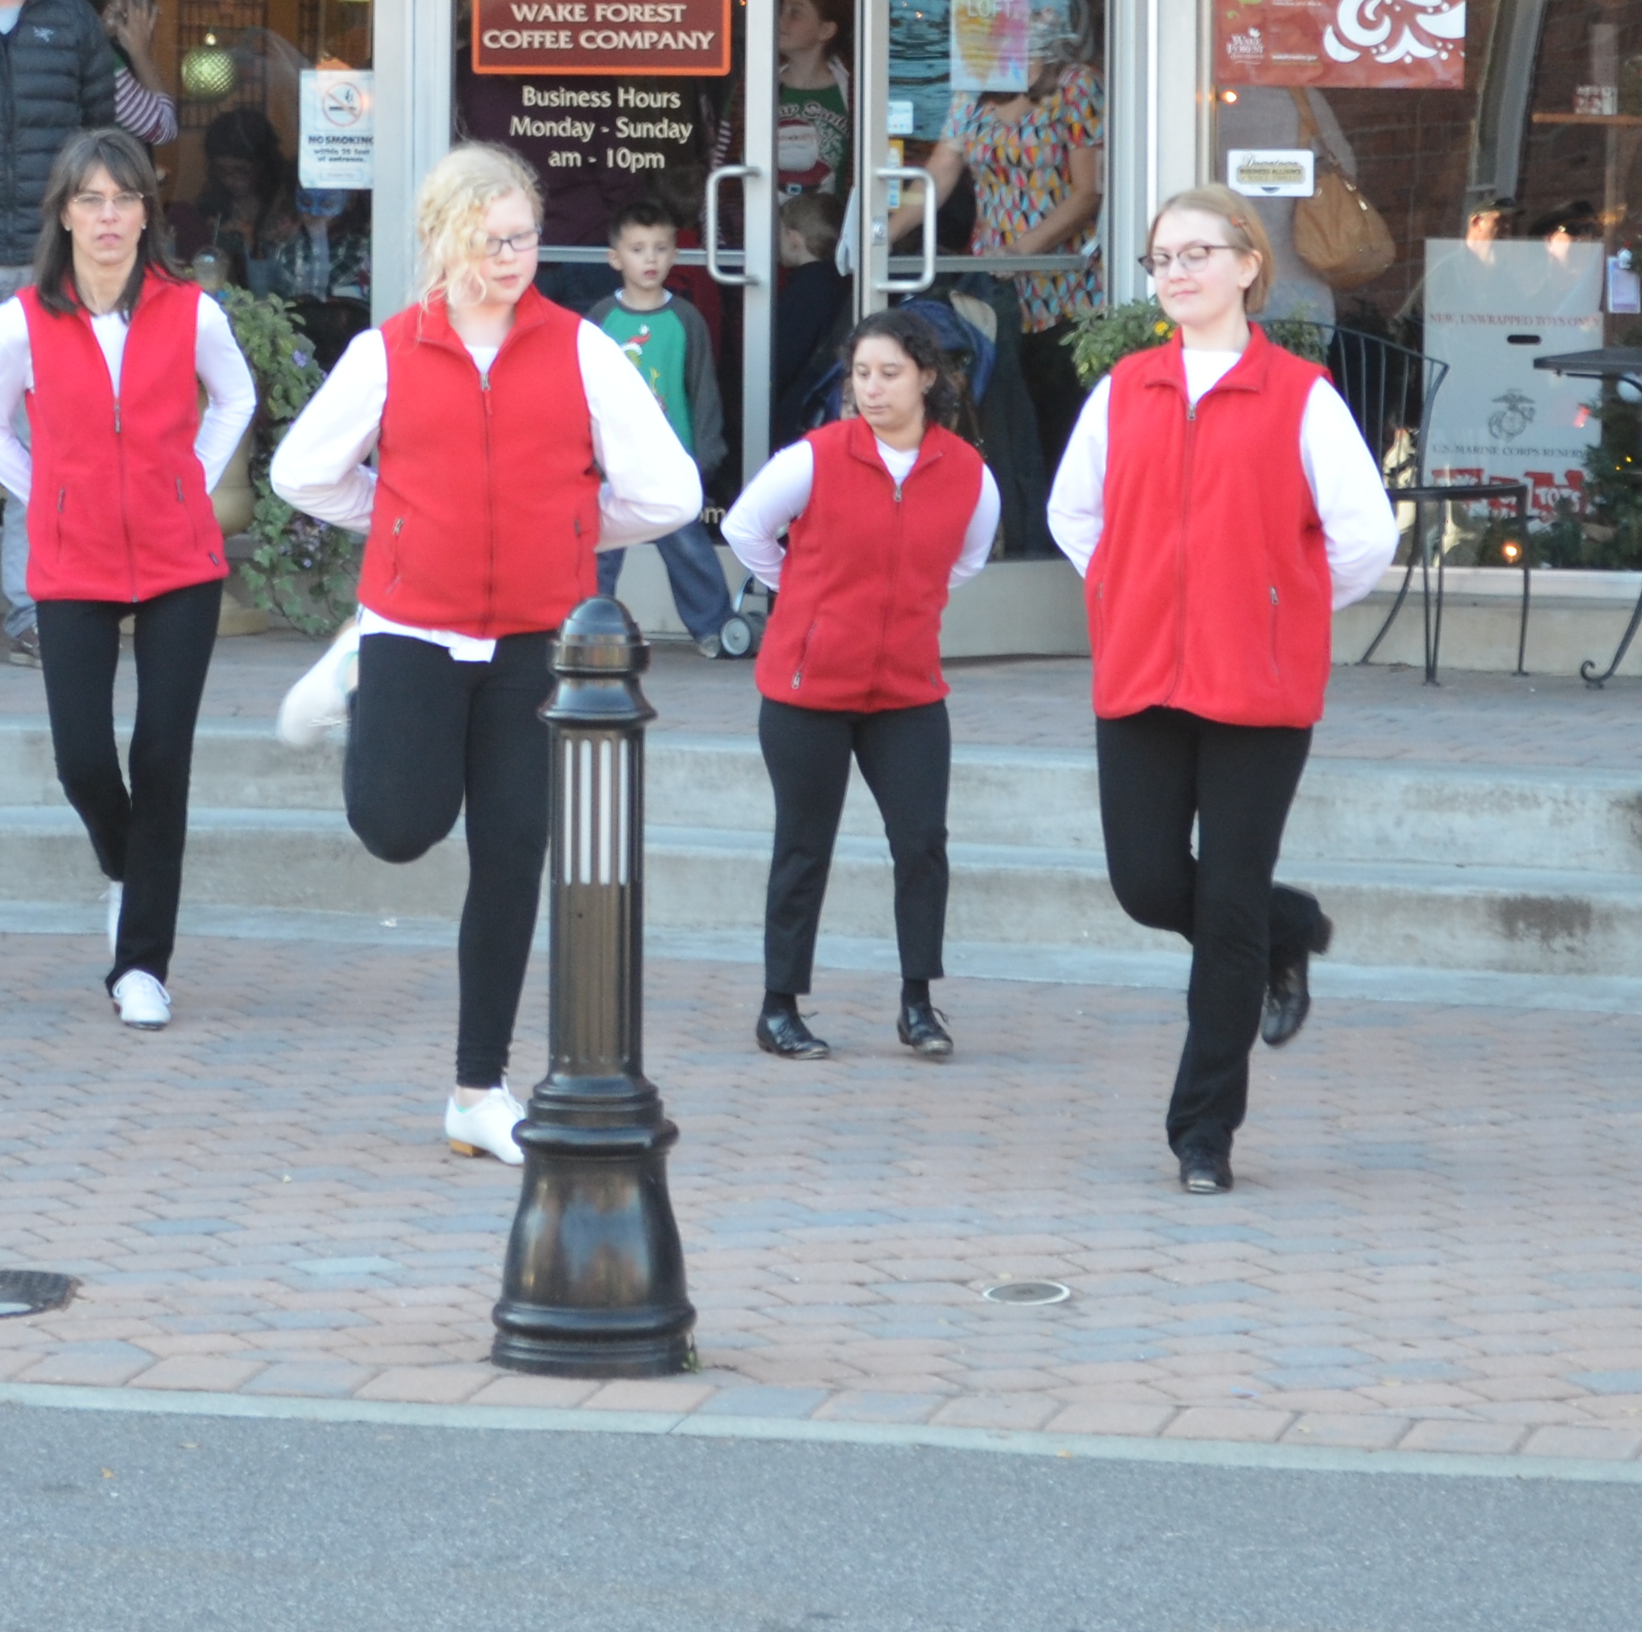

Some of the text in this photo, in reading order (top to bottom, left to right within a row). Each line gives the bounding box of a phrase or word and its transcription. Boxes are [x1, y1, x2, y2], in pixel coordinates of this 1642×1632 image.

[510, 2, 687, 24] WAKE FOREST
[481, 29, 716, 51] COFFEE COMPANY
[521, 84, 682, 109] Business Hours
[509, 115, 694, 145] Monday - Sunday
[547, 147, 666, 174] am - 10pm
[1455, 445, 1500, 457] MARINE
[1501, 447, 1540, 458] CORPS
